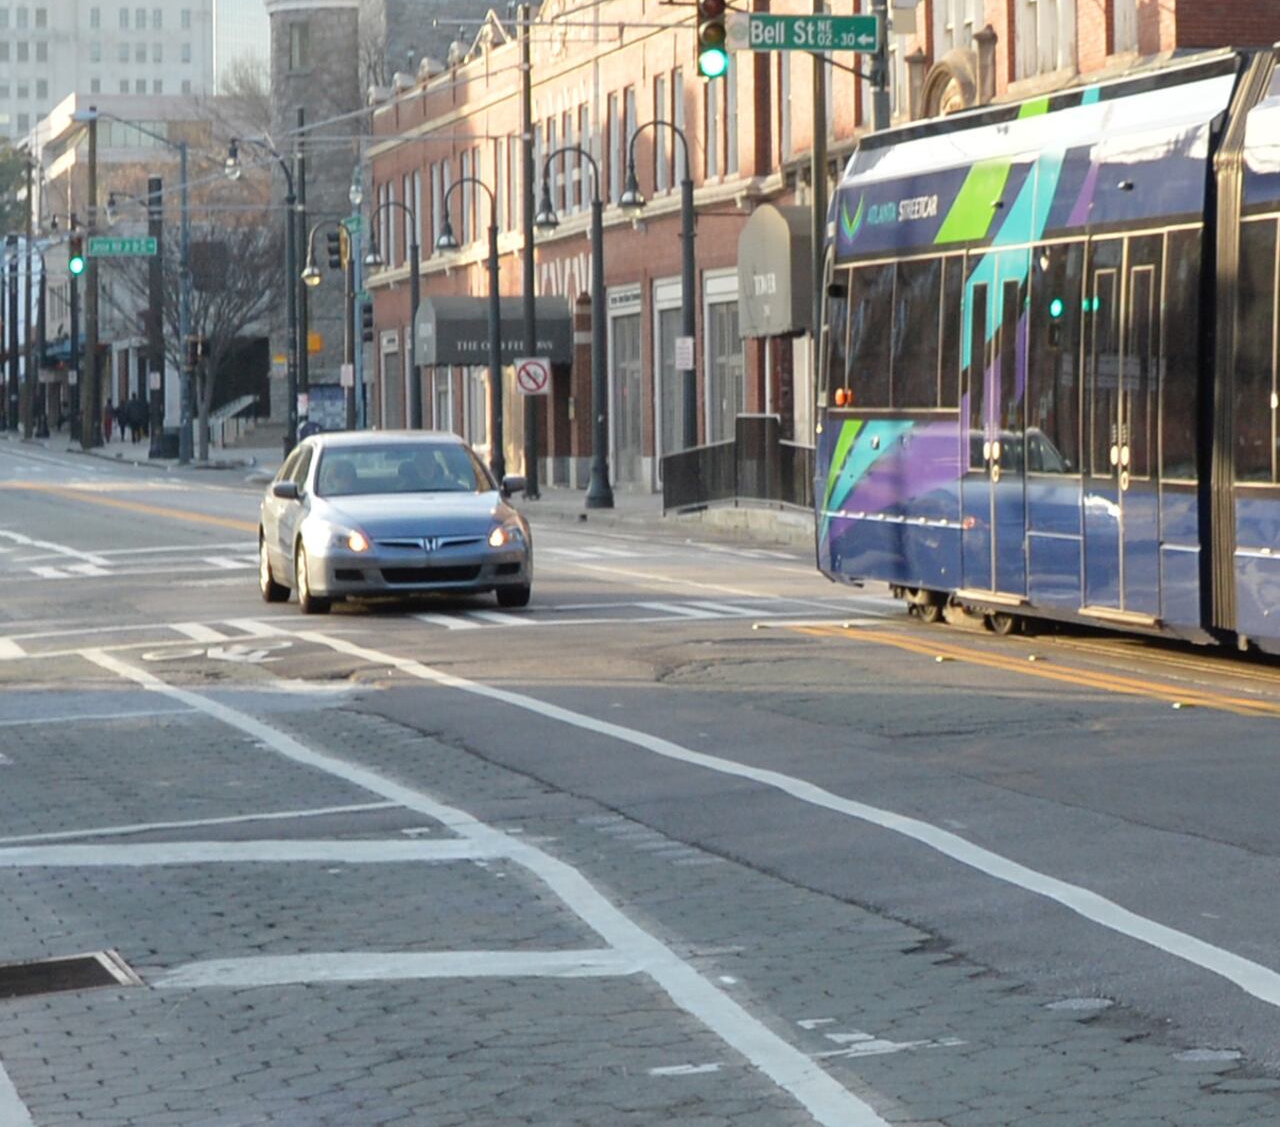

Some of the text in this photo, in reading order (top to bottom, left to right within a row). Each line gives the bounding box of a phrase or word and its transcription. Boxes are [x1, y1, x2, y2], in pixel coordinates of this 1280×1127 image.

[751, 19, 815, 45] Bell St
[817, 20, 833, 33] NE
[867, 195, 938, 225] ATLANTA STREETCAR
[457, 340, 477, 351] THE
